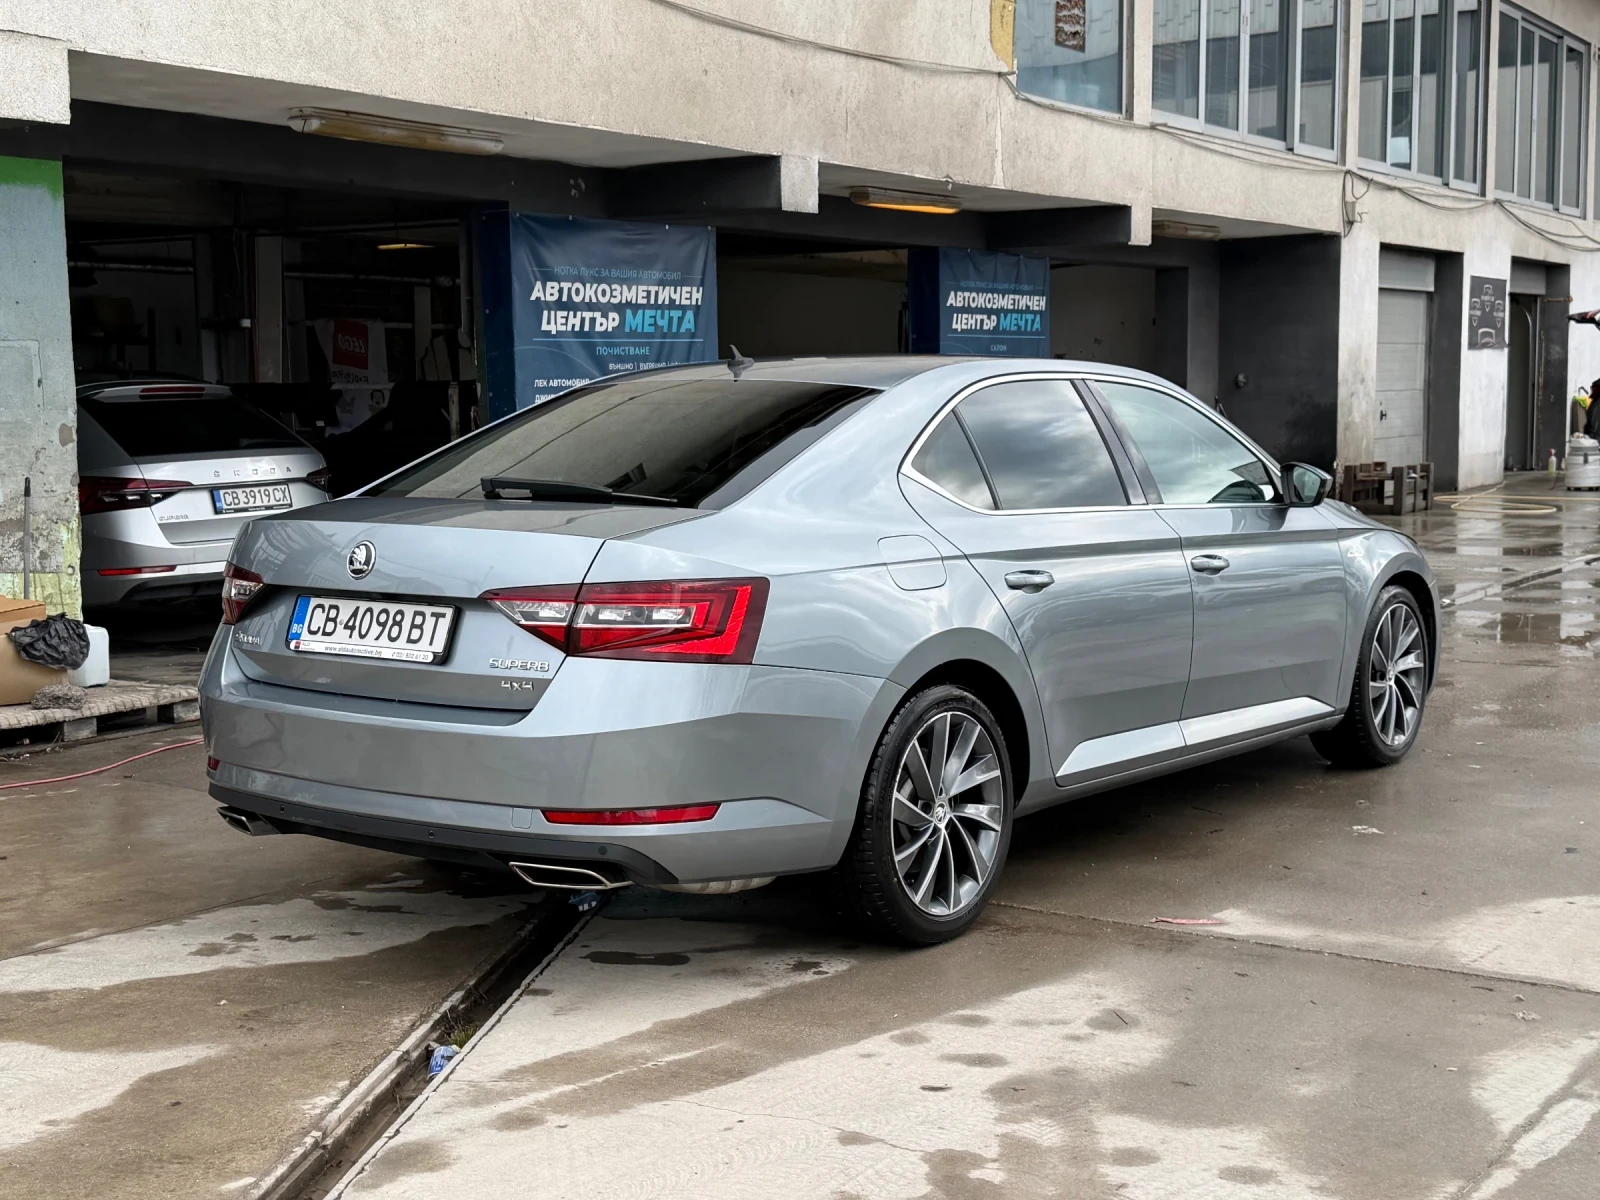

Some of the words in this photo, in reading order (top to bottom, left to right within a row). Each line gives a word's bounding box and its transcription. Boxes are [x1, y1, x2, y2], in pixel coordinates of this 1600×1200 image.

[554, 267, 578, 276] НОТКА
[580, 268, 599, 277] ЛУКС
[600, 268, 610, 278] ЗА
[611, 269, 637, 279] ВАШИЯ
[638, 270, 681, 280] АВТОМОБИЛ
[530, 281, 703, 306] АВТОКОЗМЕТИЧЕН
[946, 291, 1046, 311] АВТОКОЗМЕТИЧЕН
[541, 309, 620, 334] ЦЕНТЪР
[624, 309, 696, 333] МЕЧТА
[952, 313, 997, 332] ЦЕНТЪР
[999, 312, 1041, 332] МЕЧТА
[596, 346, 650, 356] ПОЧИСТВАНЕ
[990, 344, 1007, 352] САЛОН
[608, 362, 634, 370] ВЪНШНО
[534, 379, 548, 388] ЛЕК
[223, 490, 241, 507] CB
[241, 488, 271, 505] 3919
[272, 486, 289, 503] CX
[291, 623, 303, 634] BG
[307, 602, 339, 637] CB
[343, 605, 405, 642] 4098
[406, 610, 447, 646] BT
[489, 657, 549, 672] SUPERB
